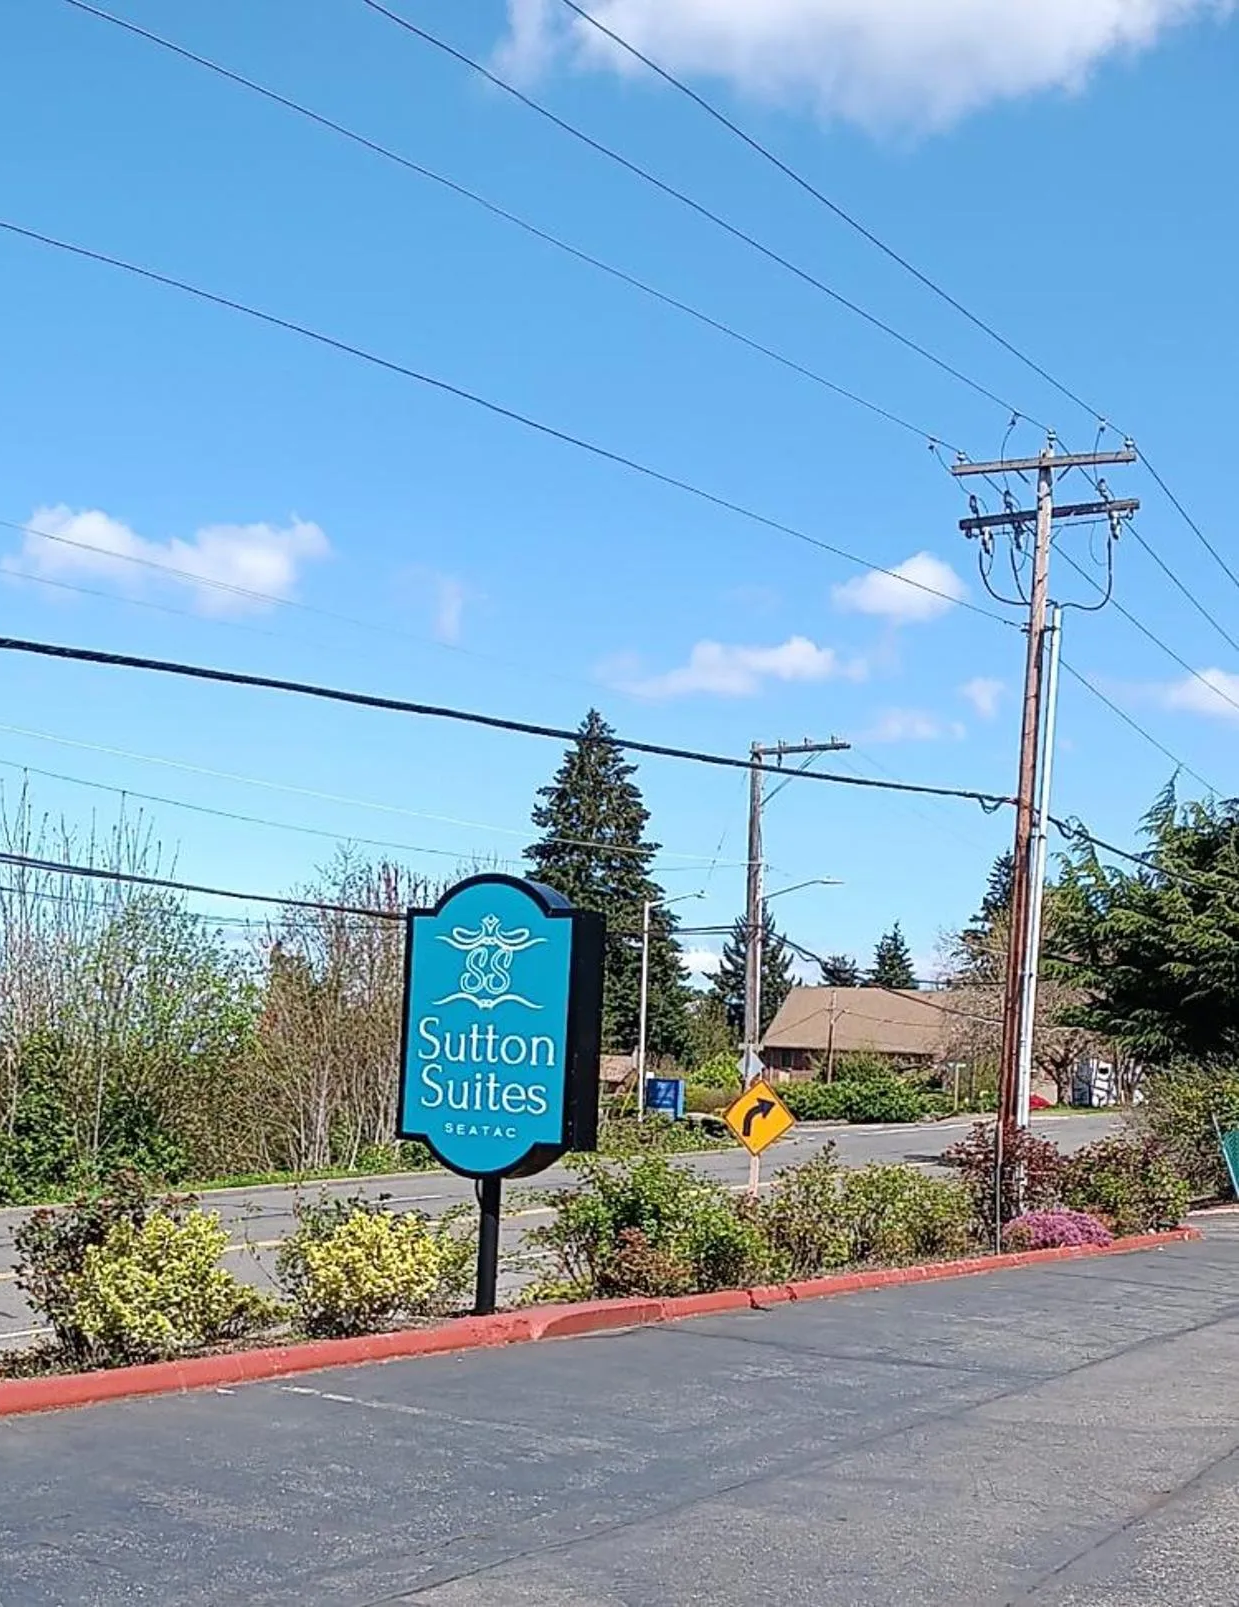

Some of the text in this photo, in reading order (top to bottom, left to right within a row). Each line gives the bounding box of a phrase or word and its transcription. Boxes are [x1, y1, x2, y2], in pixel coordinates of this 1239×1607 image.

[461, 946, 512, 993] SS
[418, 1017, 555, 1066] Sutton
[421, 1064, 548, 1113] Suites
[444, 1122, 517, 1138] SEATAC
